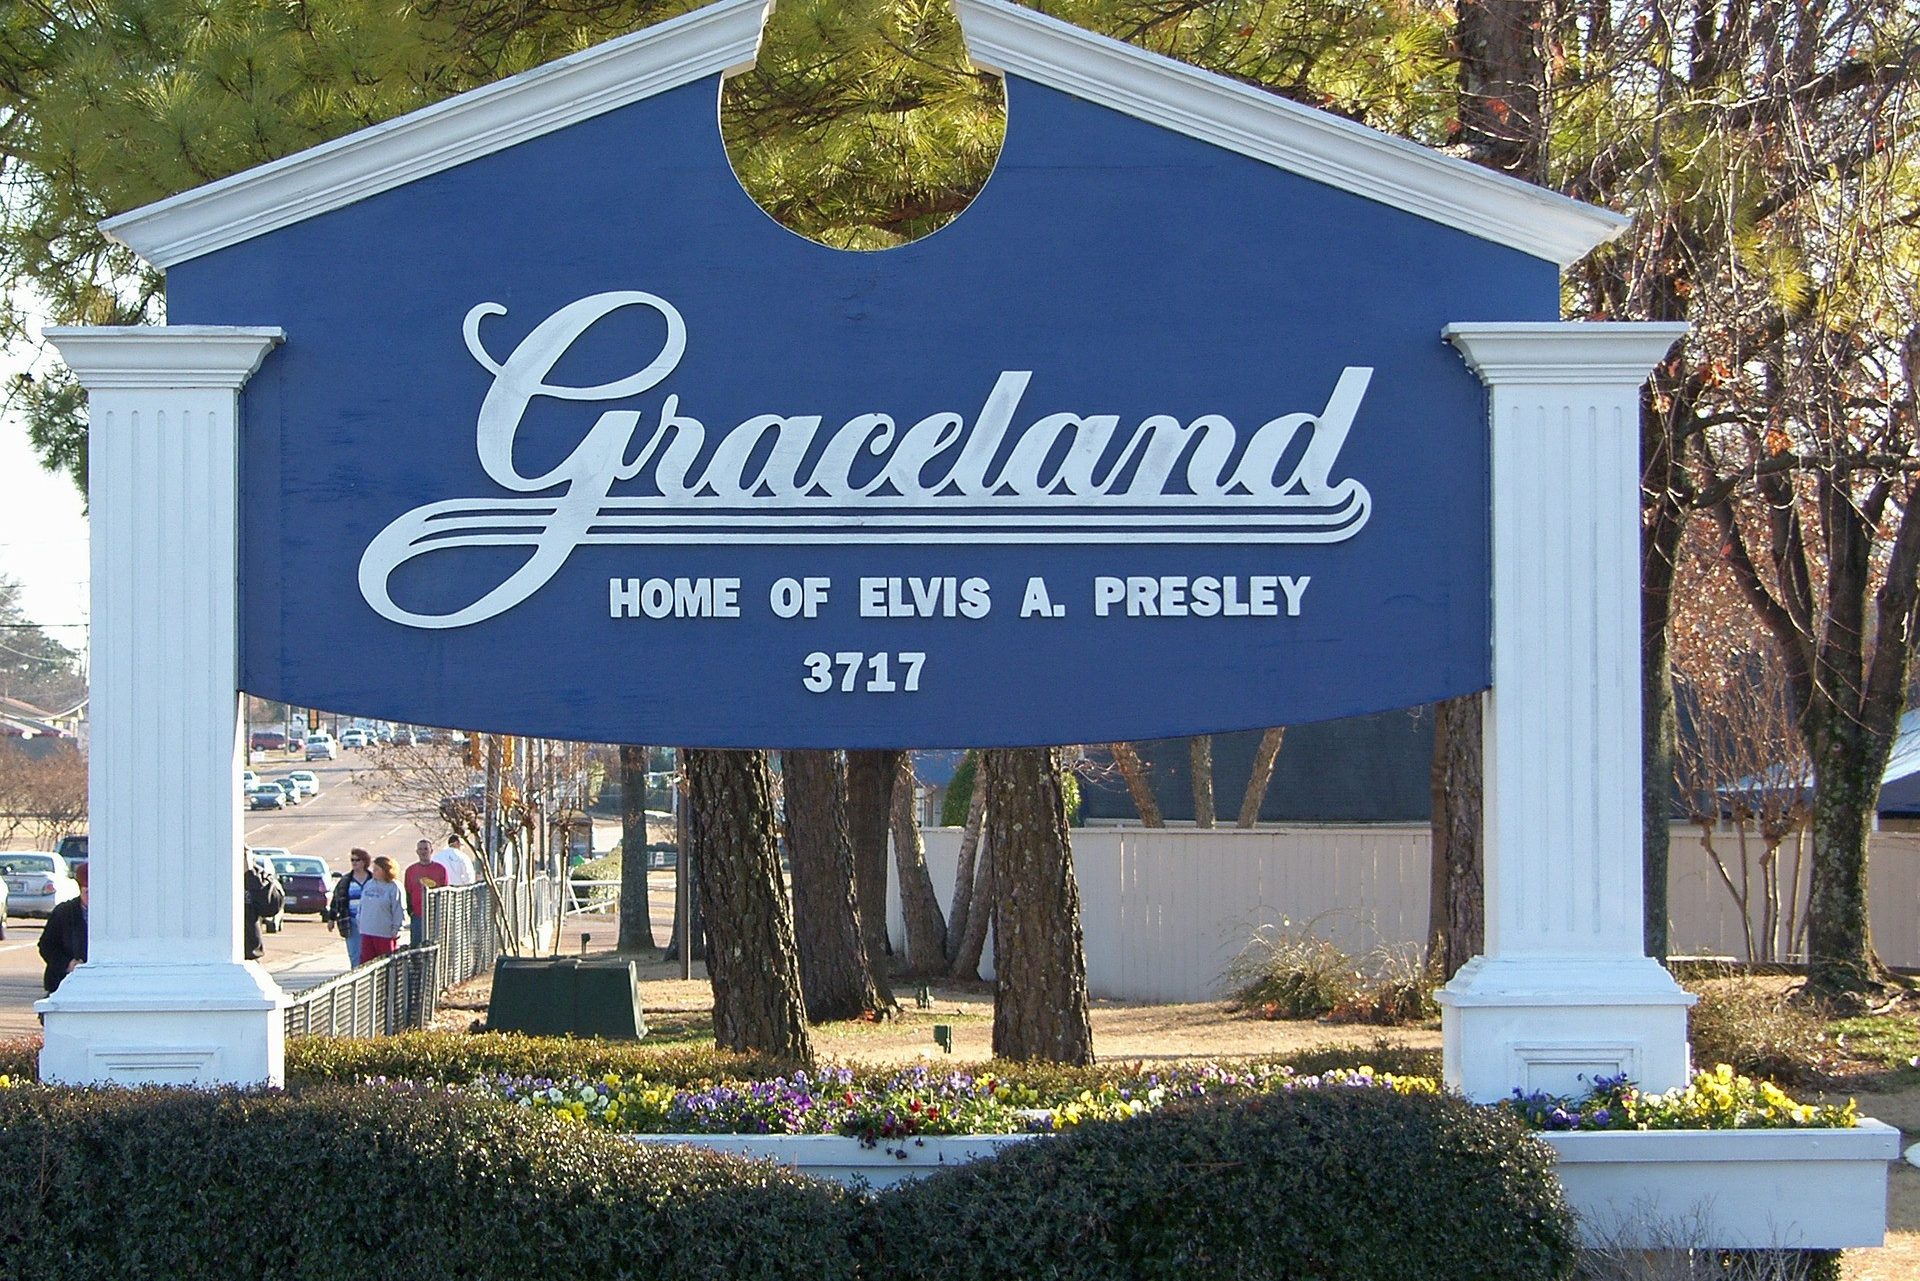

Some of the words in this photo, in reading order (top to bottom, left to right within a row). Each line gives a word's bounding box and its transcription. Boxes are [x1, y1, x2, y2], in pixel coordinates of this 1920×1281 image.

[359, 290, 1374, 629] Graceland
[609, 577, 741, 619] HOME
[770, 577, 831, 618] OF
[859, 577, 991, 619] ELVIS
[1020, 576, 1066, 618] A.
[1094, 576, 1311, 617] PRESLEY
[802, 652, 926, 693] 3717
